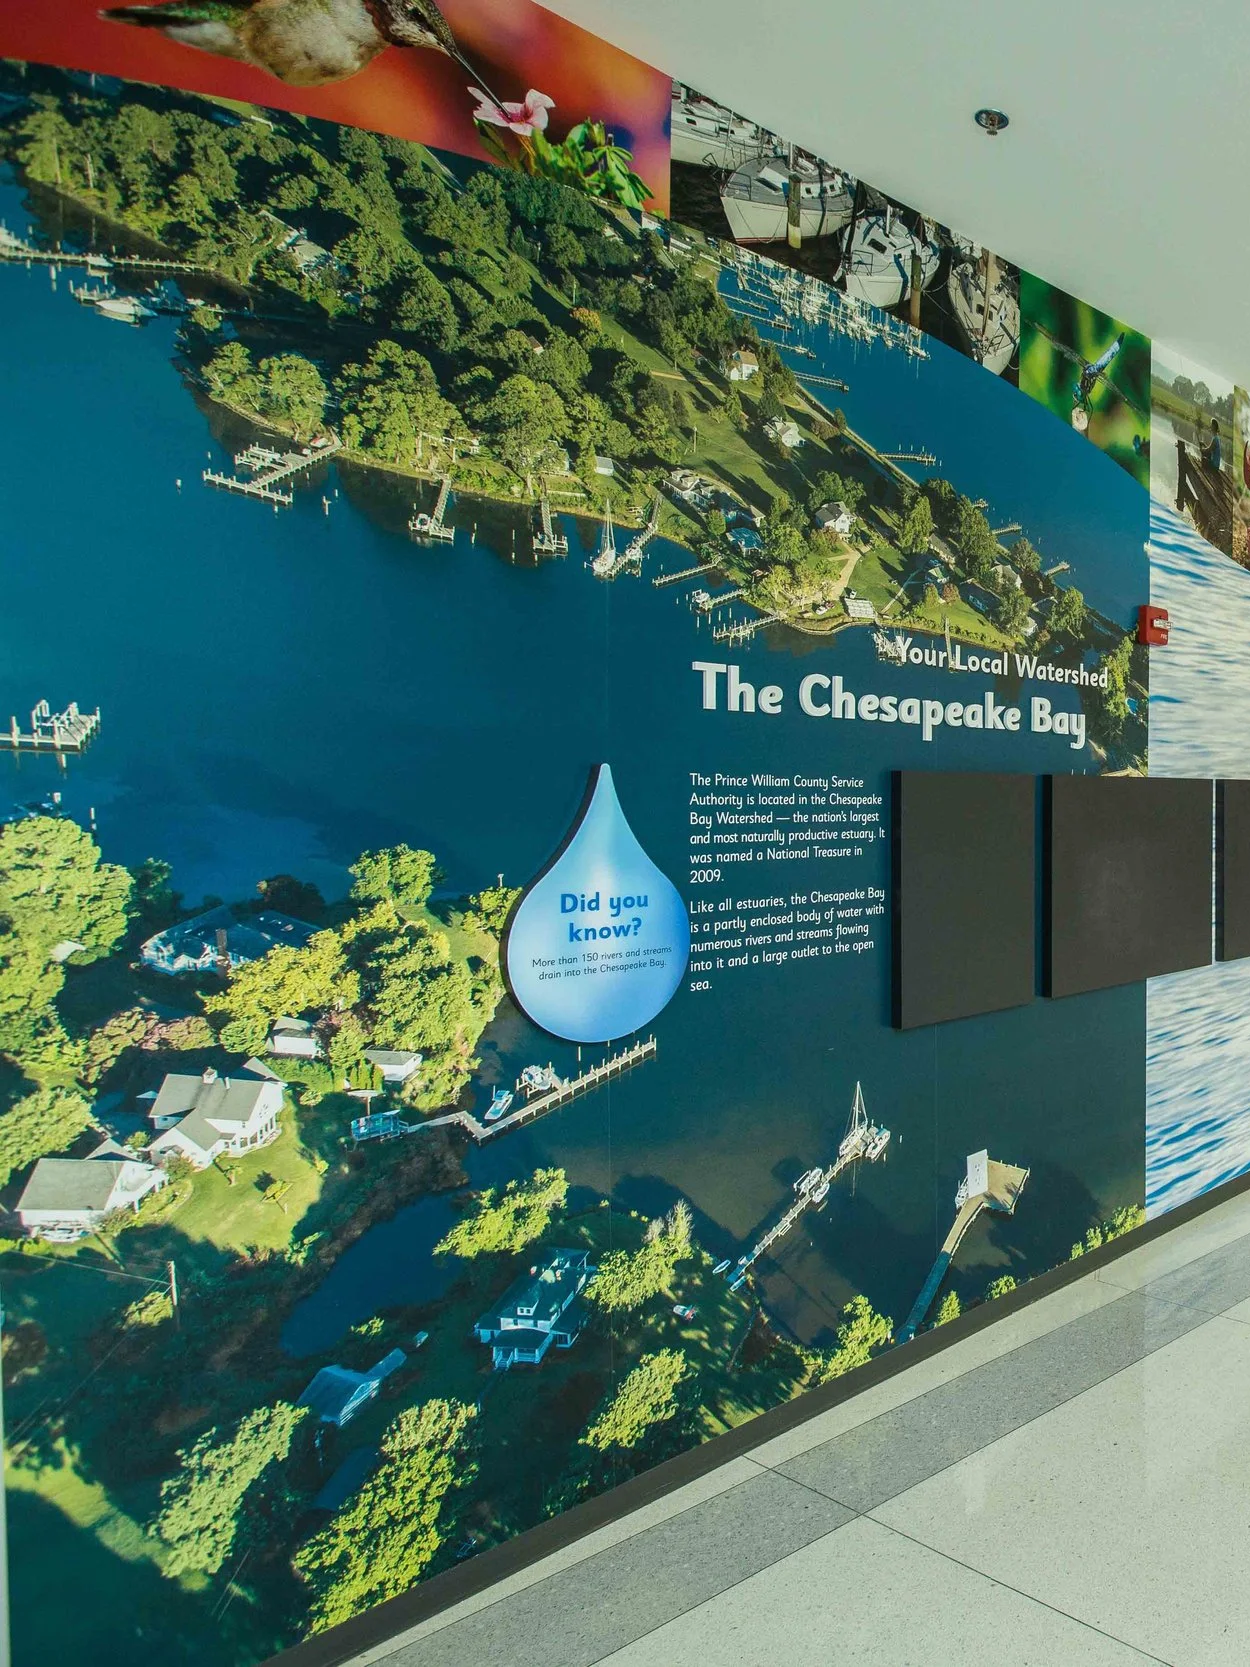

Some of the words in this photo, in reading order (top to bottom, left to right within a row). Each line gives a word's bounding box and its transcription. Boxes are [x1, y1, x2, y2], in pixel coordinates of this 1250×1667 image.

[897, 636, 947, 667] Your
[955, 645, 1008, 676] Local
[1015, 654, 1108, 688] Watershed
[692, 661, 783, 714] The
[799, 673, 1020, 741] Chesapeake
[1031, 696, 1086, 749] Bay
[690, 773, 711, 786] The
[715, 774, 747, 786] Prince
[752, 774, 790, 787] William
[794, 775, 828, 791] County
[831, 776, 863, 787] Service
[690, 793, 742, 809] Authority
[747, 794, 754, 805] is
[759, 794, 794, 805] located
[799, 794, 807, 805] in
[811, 794, 826, 805] the
[829, 794, 882, 808] Chesapeake
[690, 812, 712, 828] Bay
[717, 812, 772, 824] Watershed
[793, 813, 808, 823] the
[850, 812, 879, 827] largest
[690, 832, 710, 844] and
[714, 832, 738, 843] most
[742, 830, 784, 845] naturally
[789, 830, 838, 845] productive
[841, 830, 876, 841] estuary.
[879, 827, 885, 838] It
[690, 854, 712, 863] was
[717, 851, 752, 862] named
[757, 853, 763, 861] a
[767, 847, 809, 860] National
[813, 847, 851, 857] Treasure
[854, 847, 862, 855] in
[690, 870, 724, 883] 2009.
[560, 892, 600, 914] Did
[609, 894, 648, 917] you
[691, 901, 713, 914] Like
[719, 899, 732, 911] all
[737, 897, 787, 910] estuaries,
[791, 894, 807, 905] the
[811, 889, 865, 905] Chesapeake
[868, 887, 885, 901] Bay
[569, 918, 642, 942] know?
[691, 921, 699, 933] is
[703, 923, 710, 932] a
[714, 916, 746, 935] partly
[750, 913, 793, 927] enclosed
[797, 910, 821, 923] body
[825, 908, 834, 922] of
[837, 907, 862, 918] water
[866, 904, 884, 915] with
[691, 939, 742, 952] numerous
[746, 935, 772, 946] rivers
[775, 930, 793, 942] and
[797, 927, 833, 940] streams
[836, 923, 869, 940] flowing
[532, 957, 555, 968] More
[558, 956, 578, 965] than
[582, 953, 598, 962] 150
[601, 951, 623, 961] rivers
[626, 948, 640, 957] and
[643, 945, 672, 956] streams
[691, 960, 712, 972] into
[717, 957, 723, 969] it
[728, 953, 748, 967] and
[753, 956, 759, 964] a
[763, 950, 788, 965] large
[792, 946, 819, 959] outlet
[822, 945, 832, 955] to
[835, 942, 849, 953] the
[853, 939, 874, 954] open
[539, 969, 562, 980] drain
[564, 967, 581, 977] into
[584, 965, 597, 975] the
[600, 961, 647, 975] Chesapeake
[650, 958, 667, 969] Bay.
[691, 980, 712, 991] sea.
